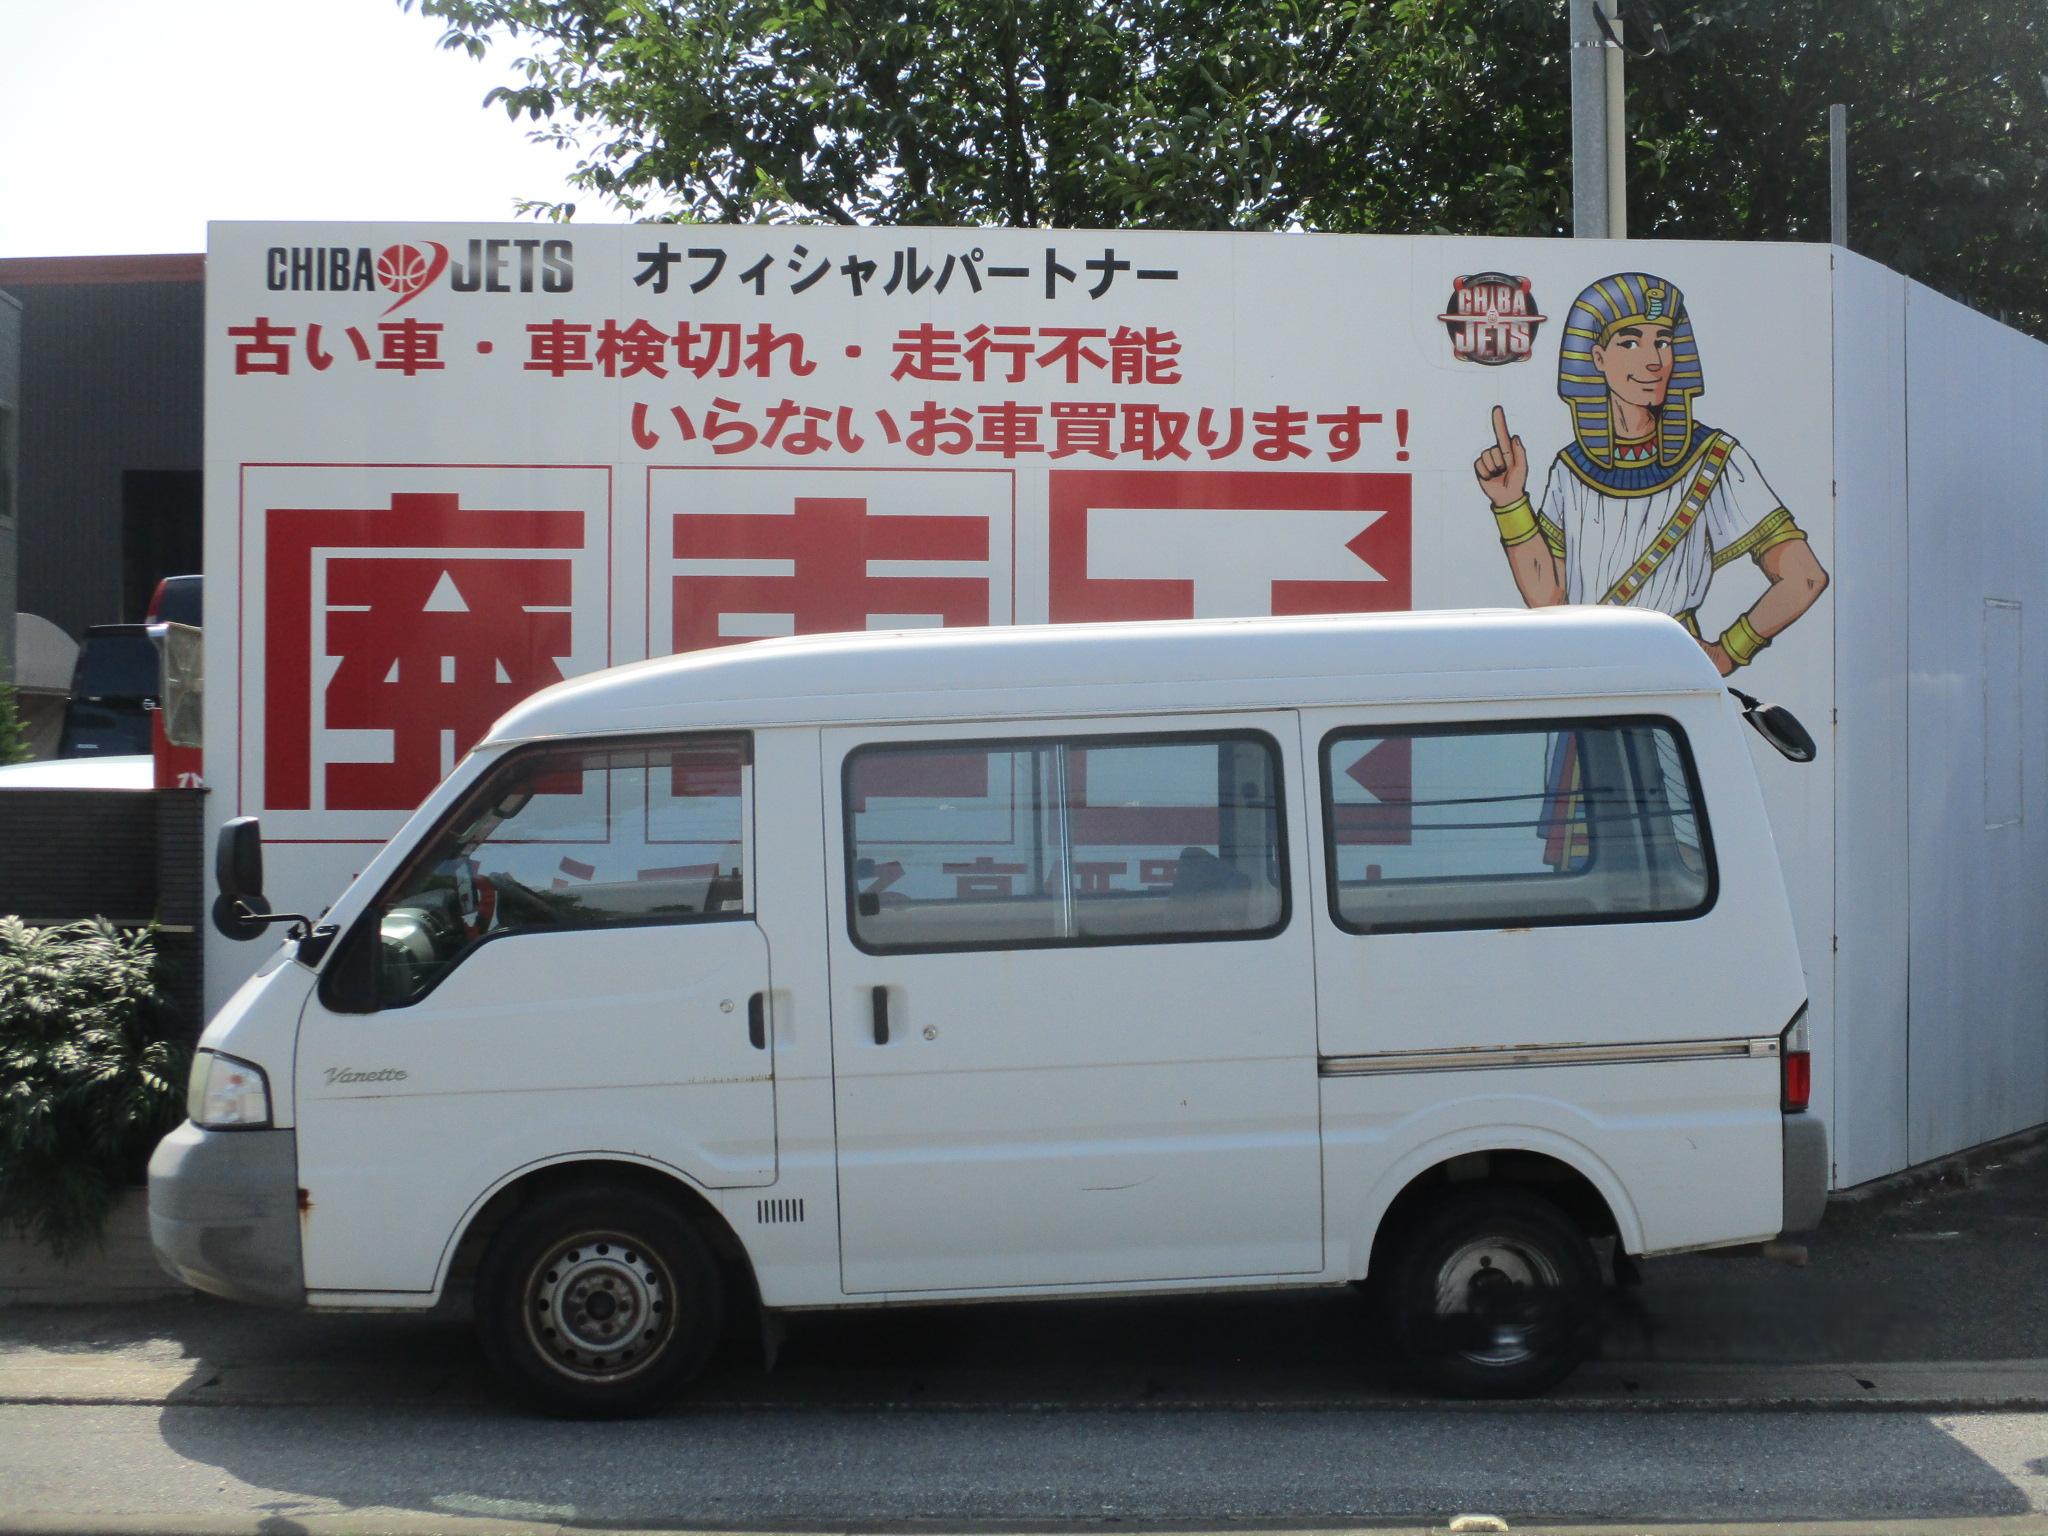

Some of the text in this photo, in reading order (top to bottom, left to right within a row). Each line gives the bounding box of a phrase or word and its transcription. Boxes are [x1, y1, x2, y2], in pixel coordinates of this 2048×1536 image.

[267, 239, 574, 293] CHIBA JETS
[635, 242, 1178, 299] オフィシャルパートナー
[1457, 286, 1527, 314] CHIBA
[227, 316, 1182, 386] 古い車・車検切れ・走行不能
[1455, 322, 1530, 357] JETS
[324, 1066, 408, 1087] Vanette
